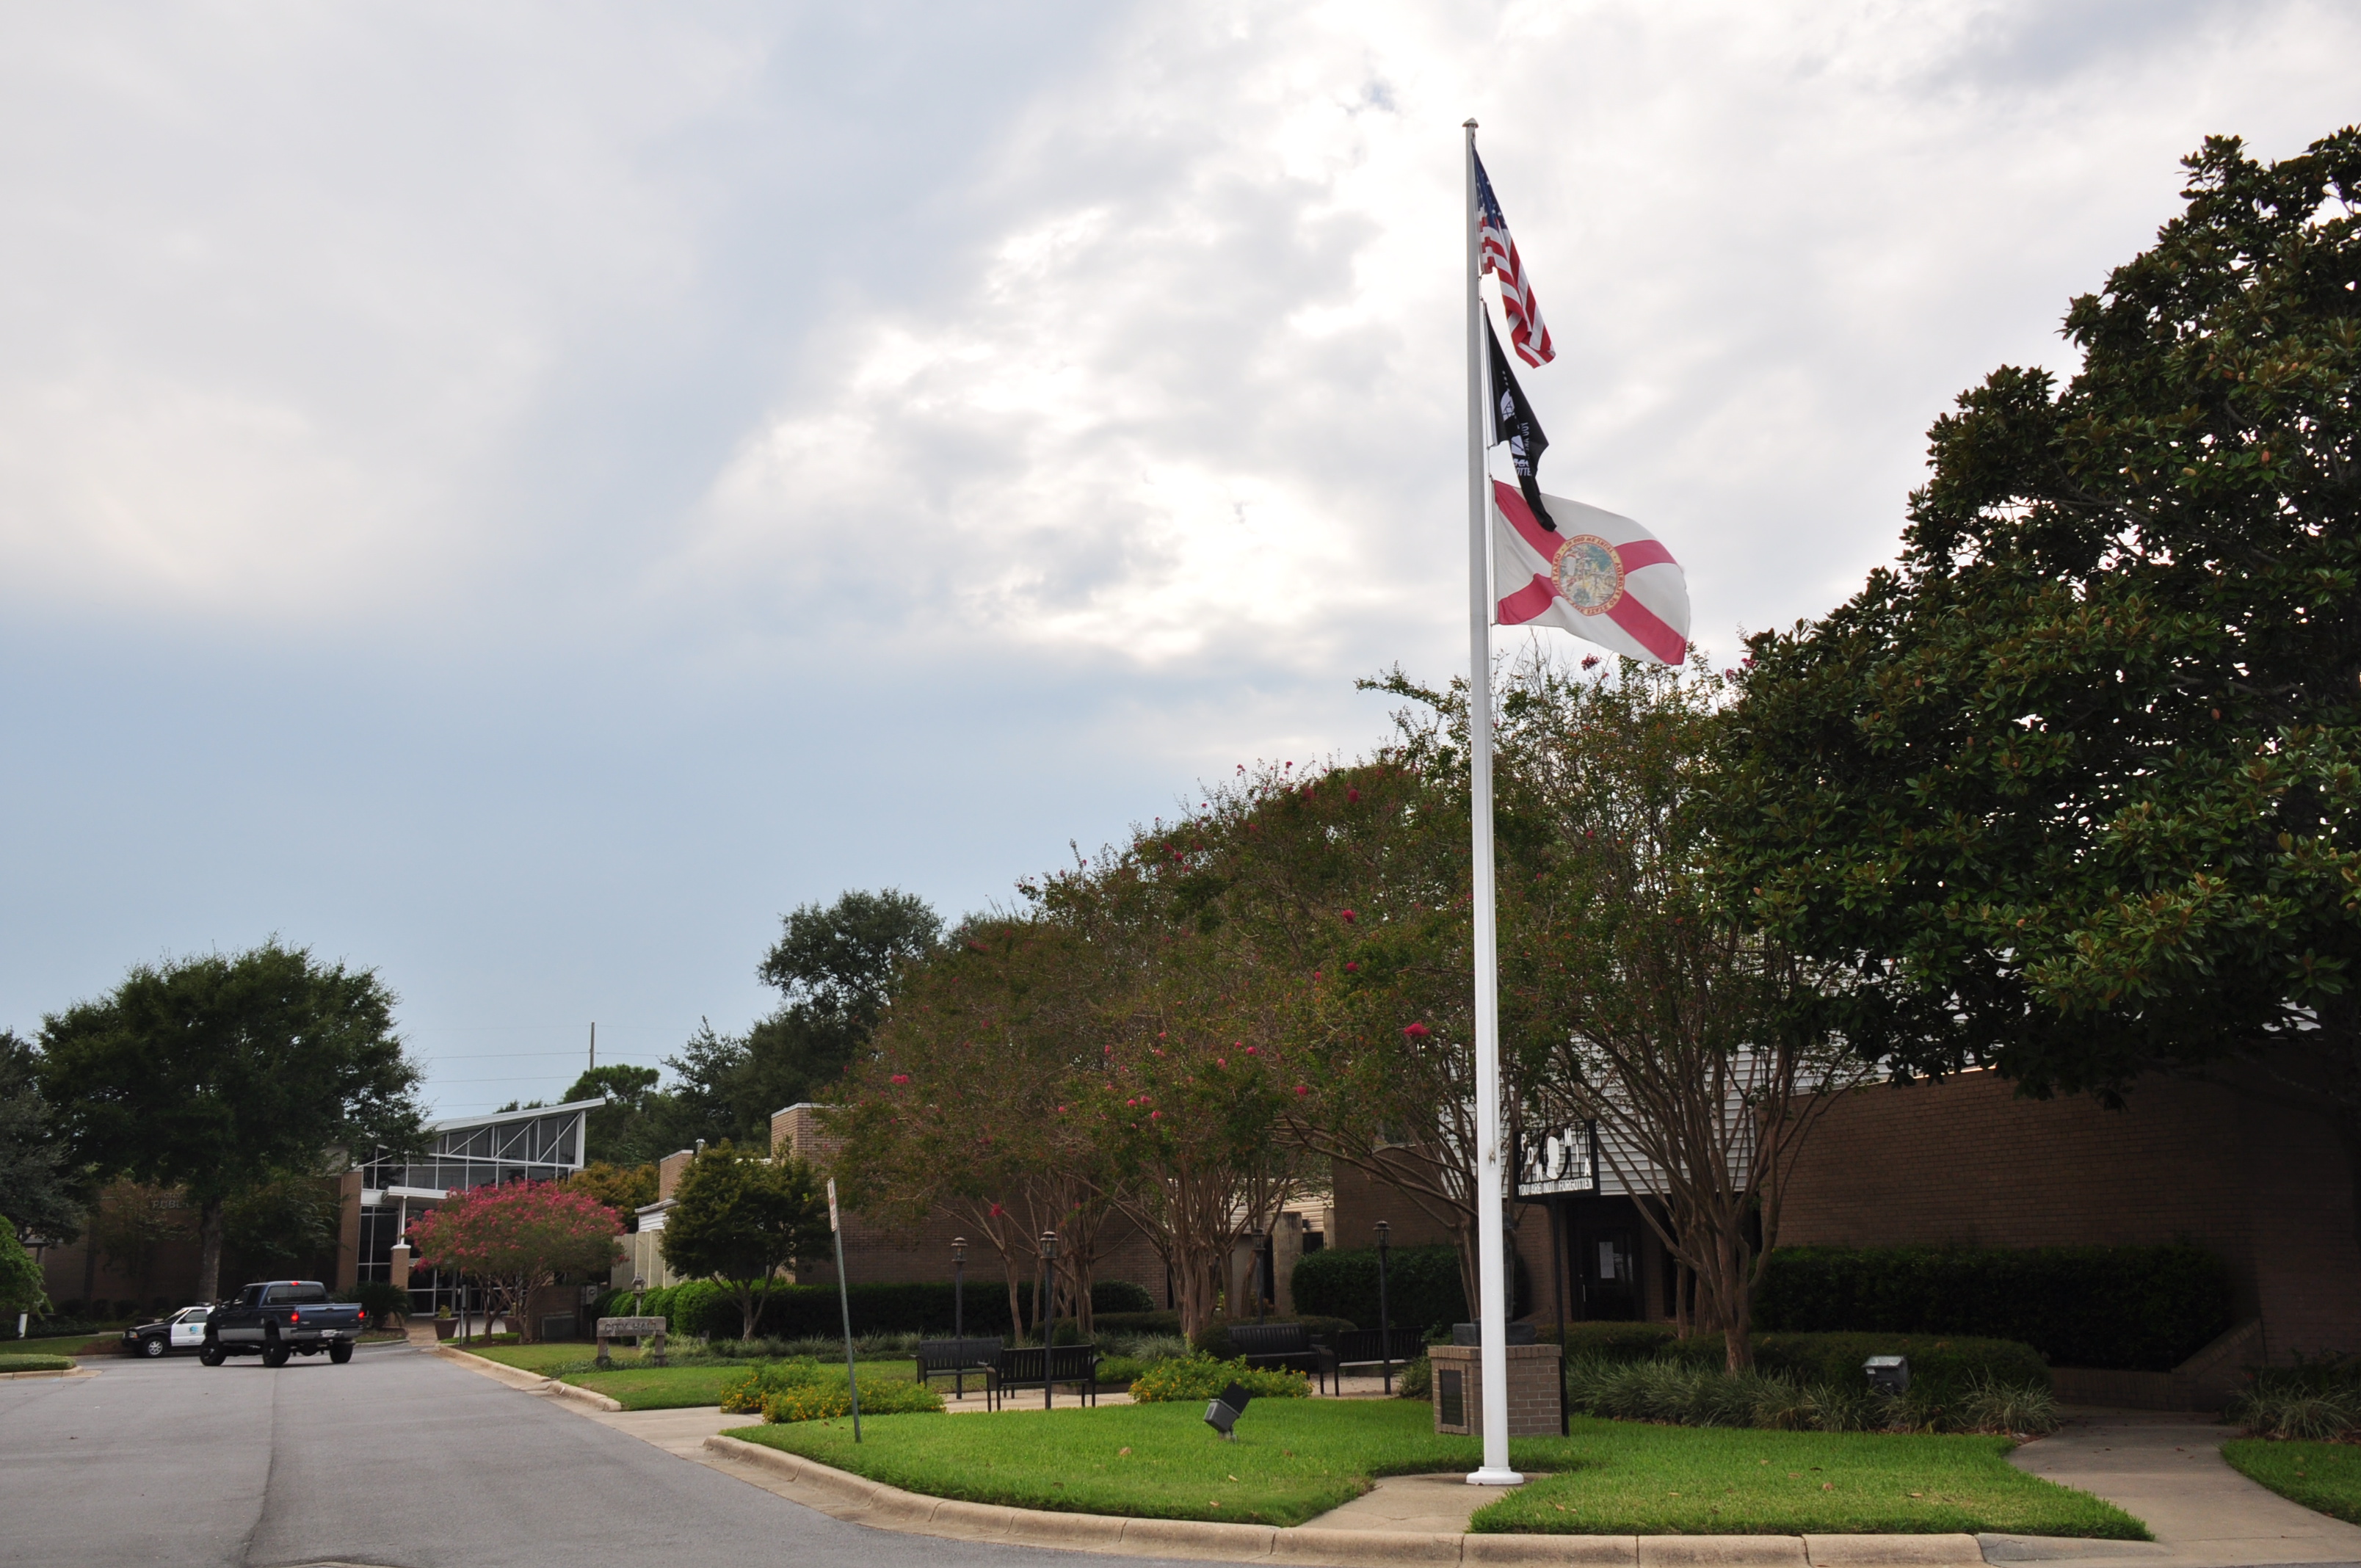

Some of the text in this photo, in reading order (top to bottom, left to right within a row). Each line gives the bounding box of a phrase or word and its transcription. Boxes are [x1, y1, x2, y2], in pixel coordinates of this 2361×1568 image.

[1518, 1177, 1593, 1196] YOU ARE NOT FORGOTTEN
[604, 1321, 661, 1334] CITY HALL
